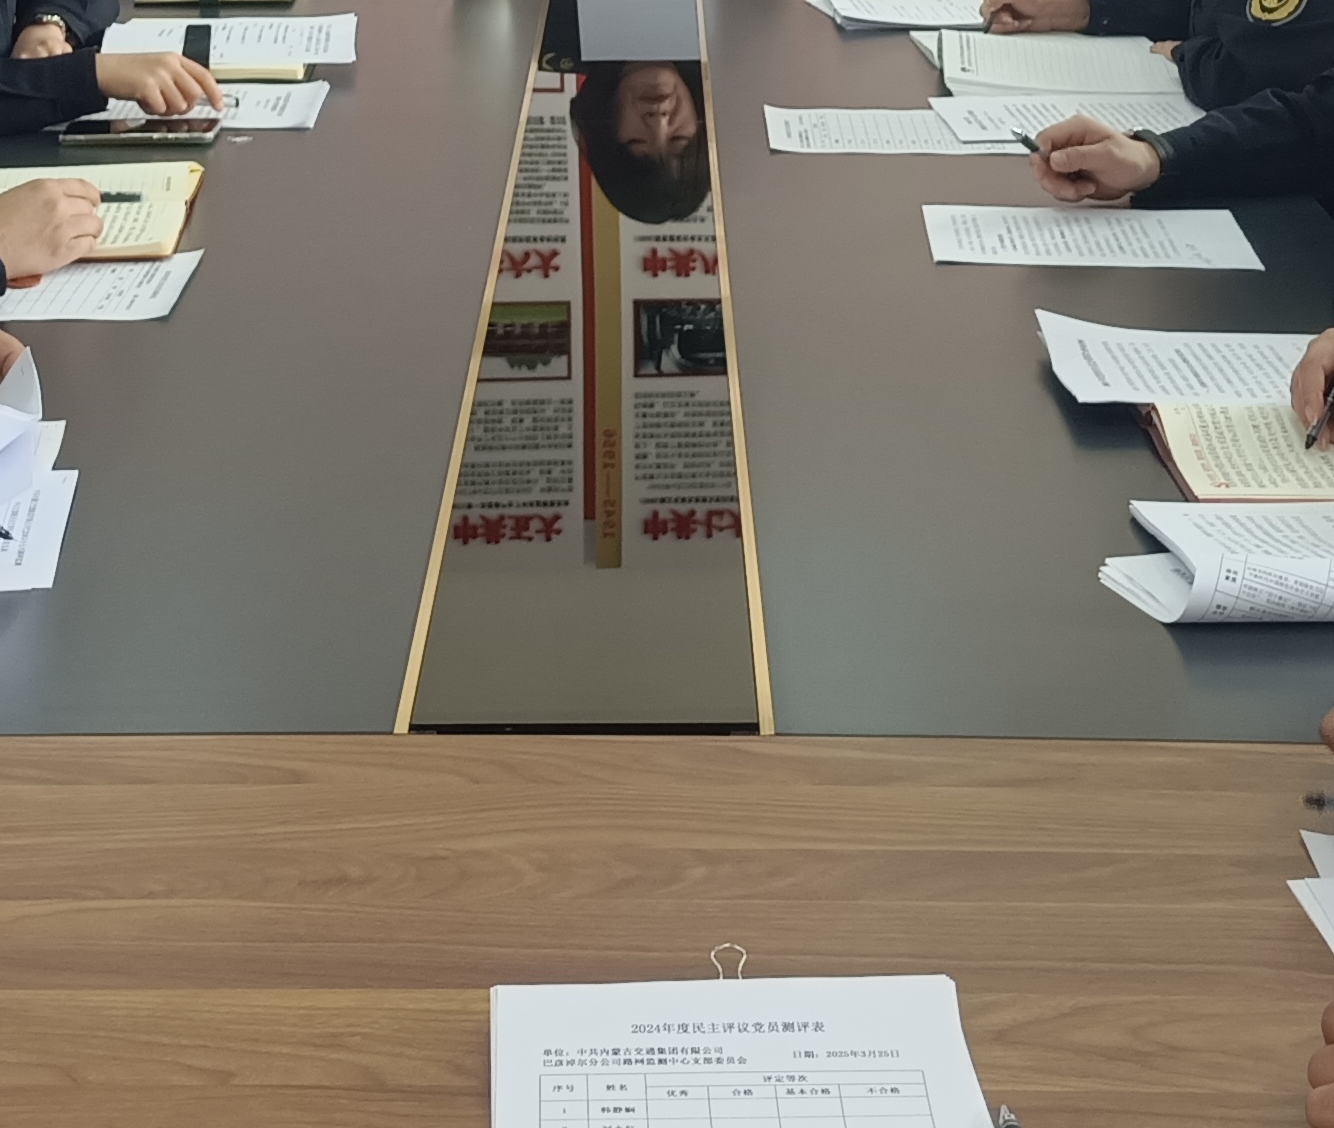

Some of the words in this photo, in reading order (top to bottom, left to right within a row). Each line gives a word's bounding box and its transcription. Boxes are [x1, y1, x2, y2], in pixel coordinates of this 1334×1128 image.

[631, 1020, 826, 1035] 2024年度民主评议党员测评表
